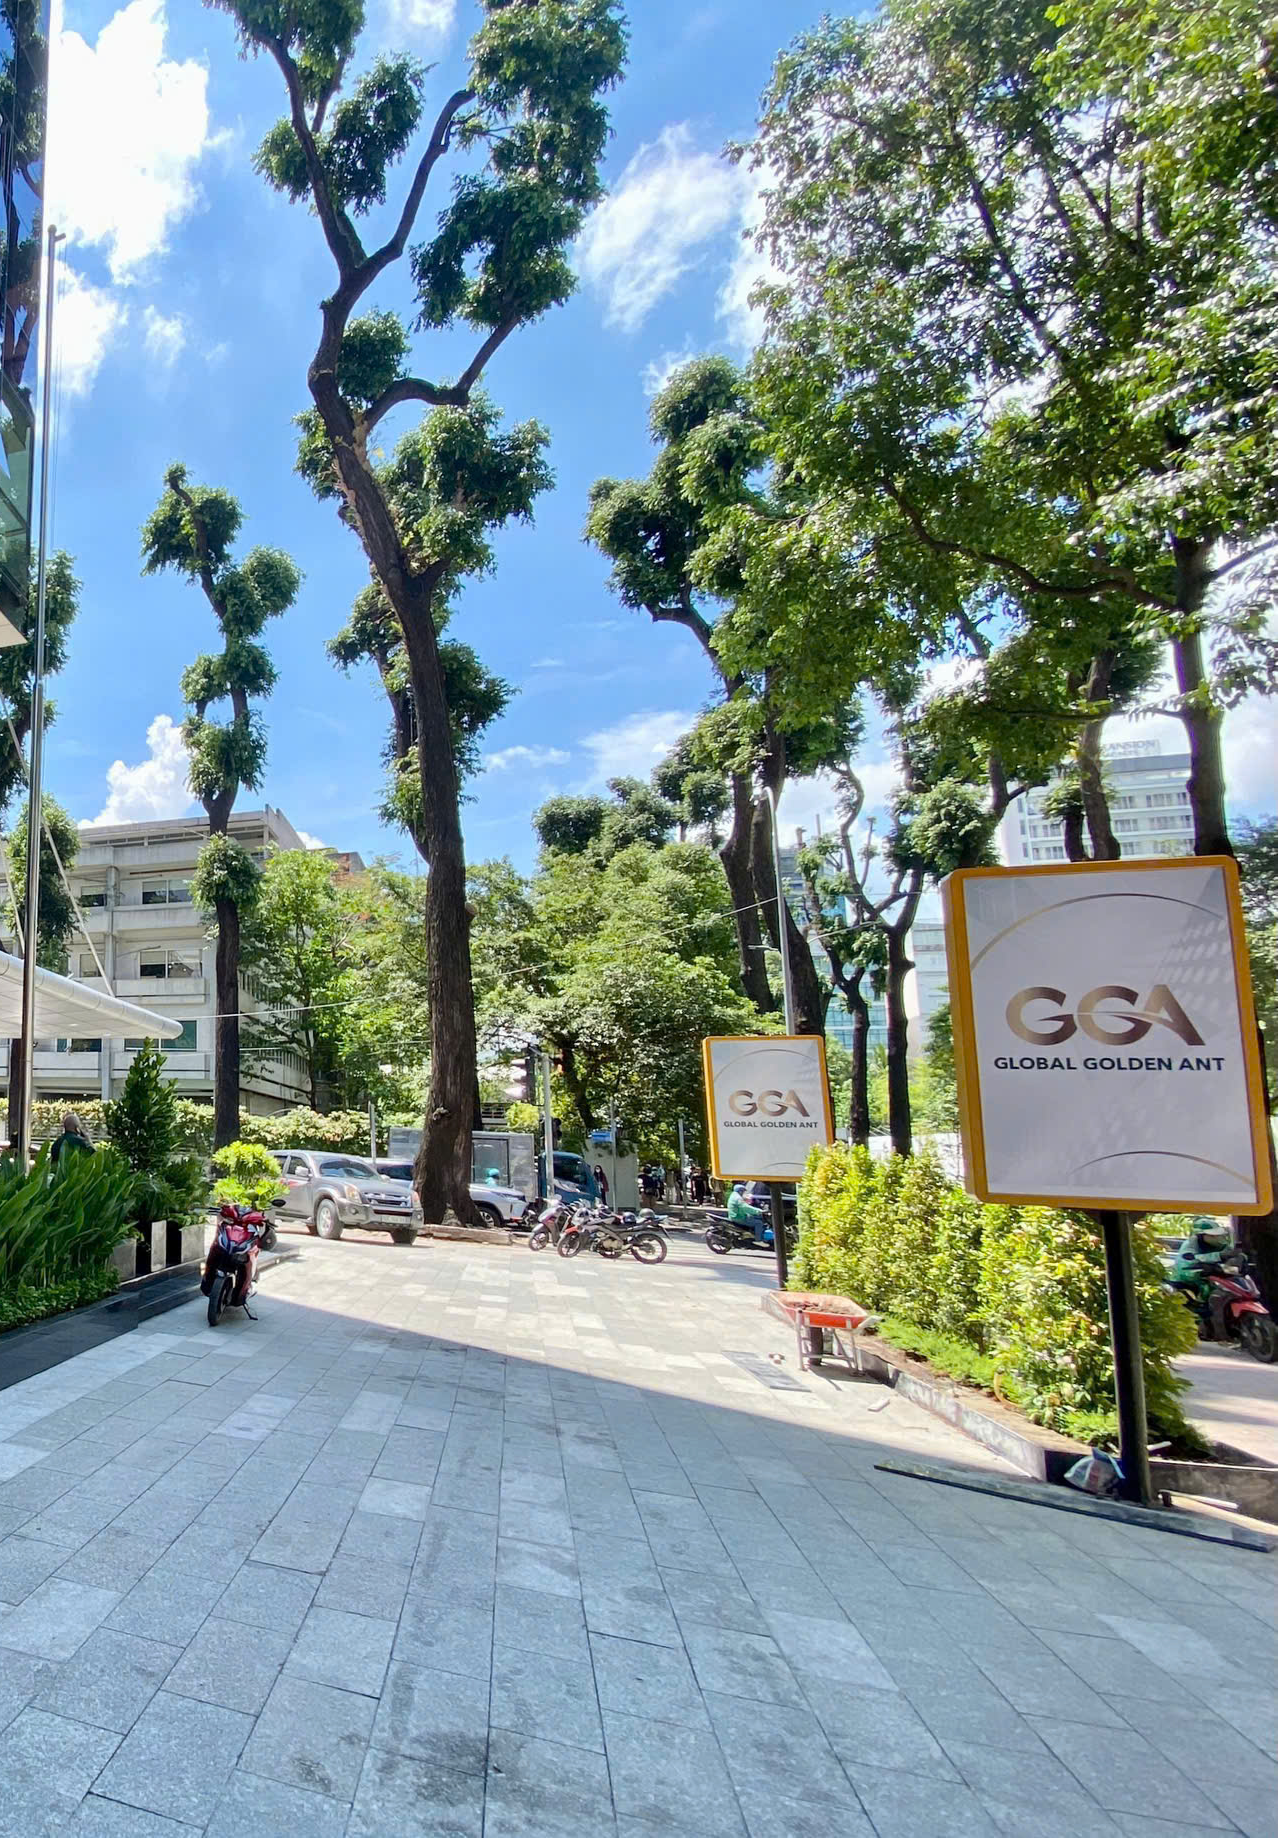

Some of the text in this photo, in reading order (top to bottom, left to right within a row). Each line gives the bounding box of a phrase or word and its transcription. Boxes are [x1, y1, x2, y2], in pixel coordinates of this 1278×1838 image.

[1005, 984, 1207, 1046] GGA
[994, 1057, 1226, 1072] GLOBAL GOLDEN ANT
[729, 1089, 811, 1118] GGA
[723, 1120, 819, 1129] GLOBAL GOLDEN ANT
